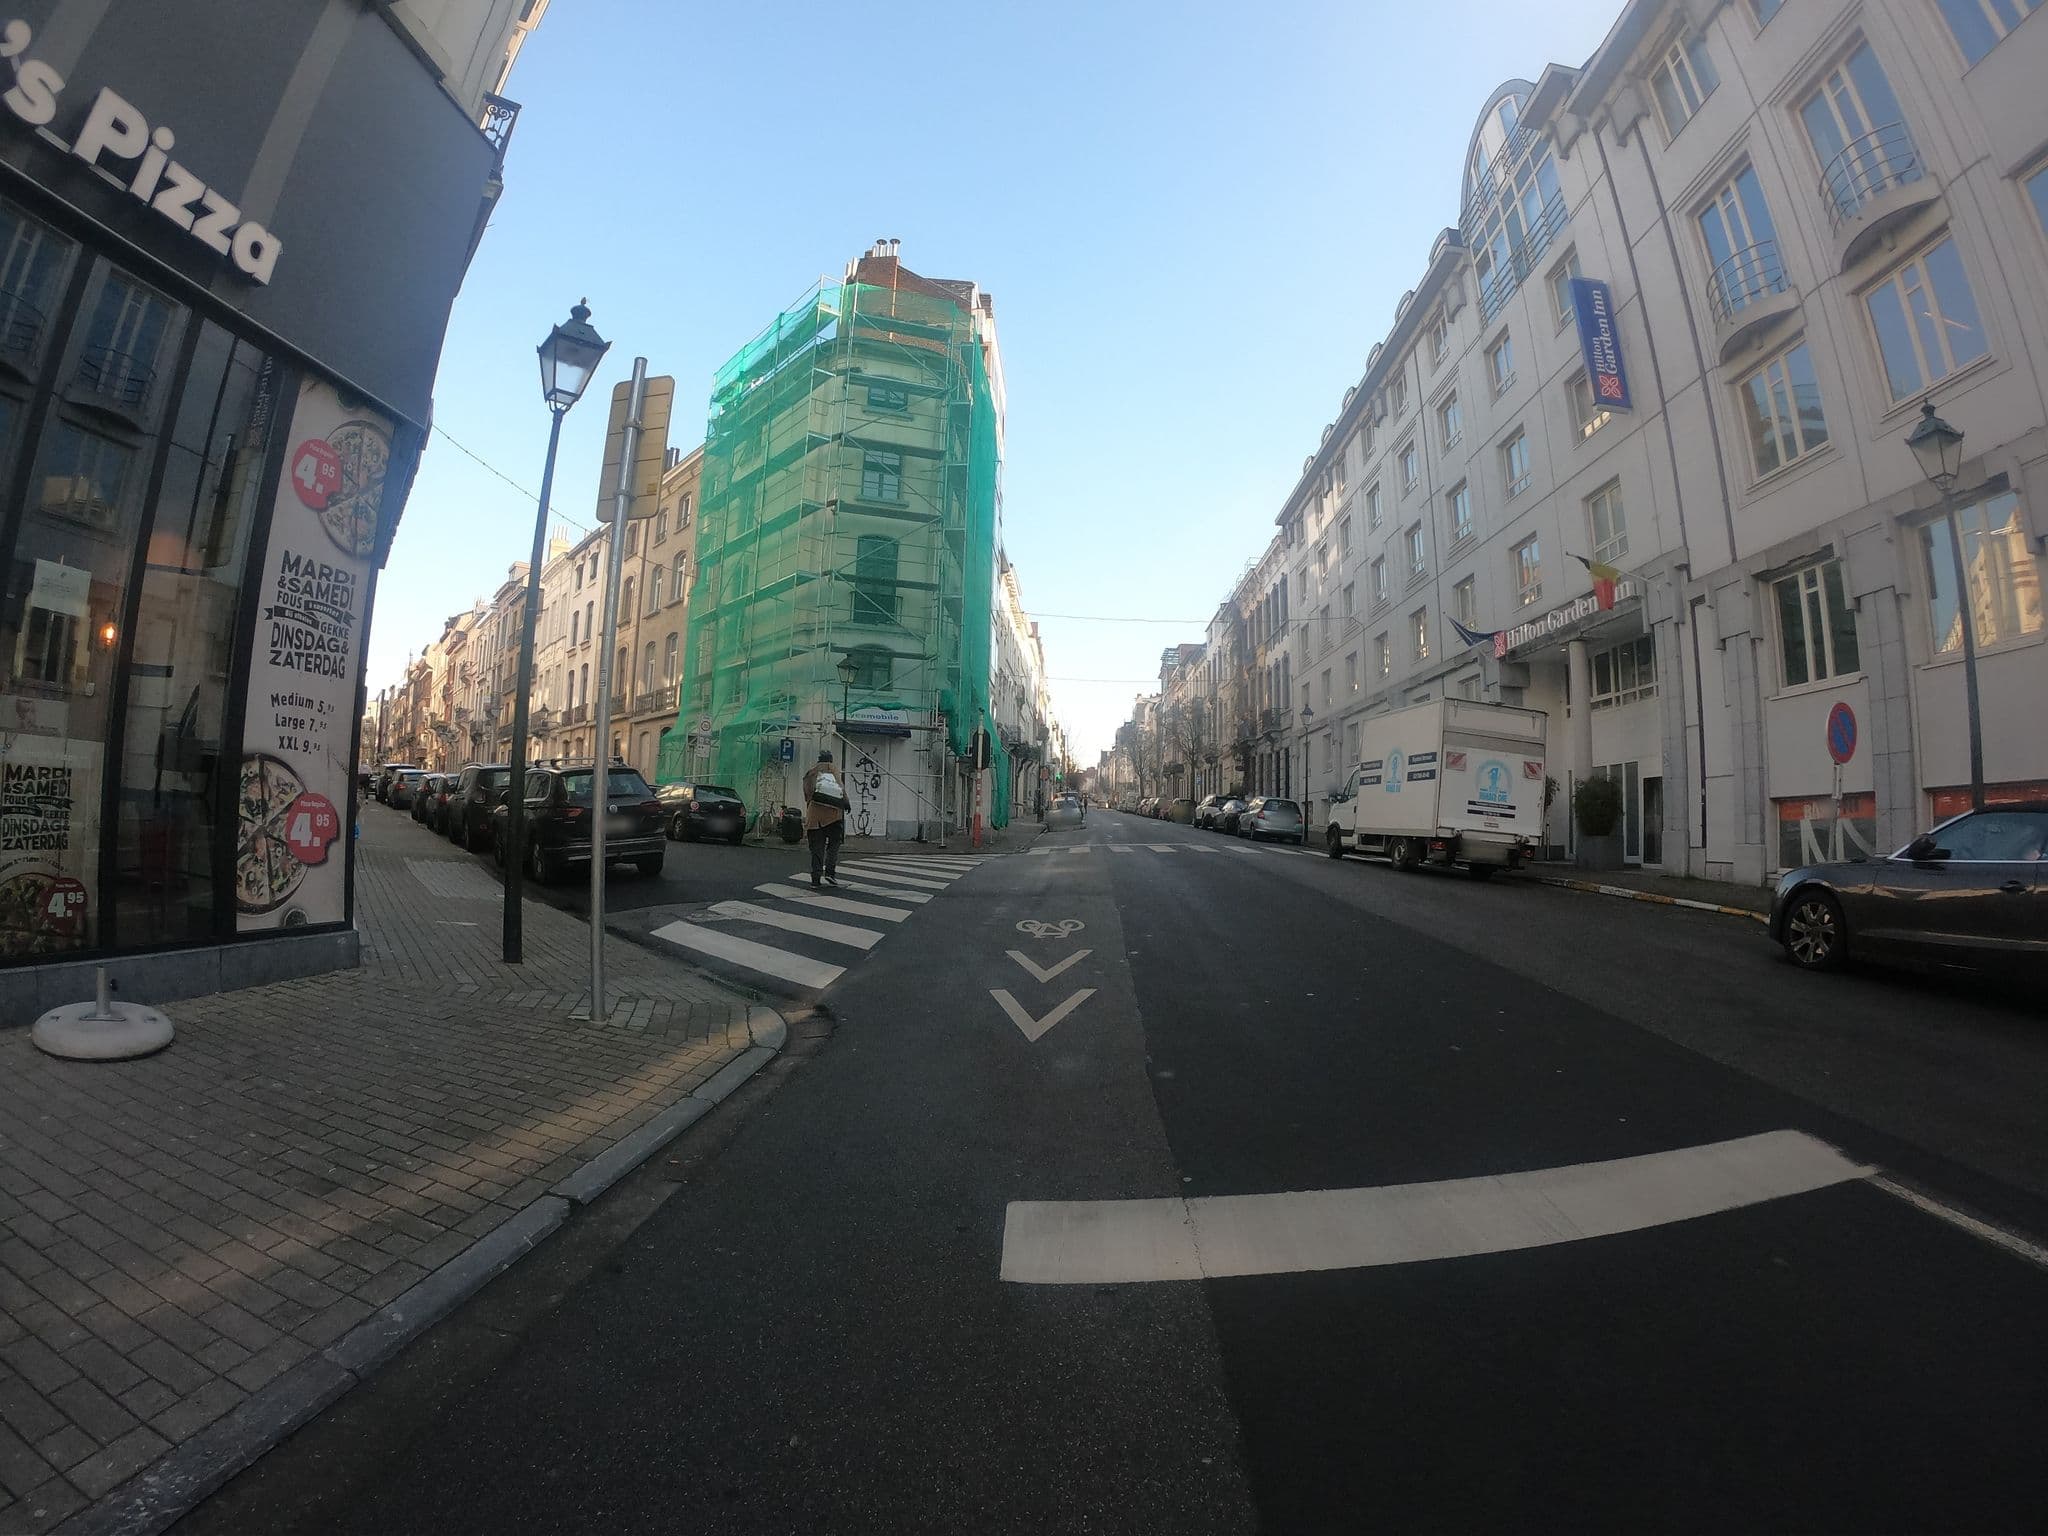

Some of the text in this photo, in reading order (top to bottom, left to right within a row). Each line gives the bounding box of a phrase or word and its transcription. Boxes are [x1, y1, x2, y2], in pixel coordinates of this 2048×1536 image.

[71, 86, 283, 286] Pizza
[1592, 289, 1618, 375] Garden Inn
[280, 549, 357, 585] MARDI
[277, 590, 302, 609] FOUS
[320, 621, 350, 640] GEKKE
[1506, 620, 1546, 650] Hilton
[1547, 596, 1599, 631] Garden
[269, 650, 346, 680] ZATERDAG
[271, 692, 314, 710] Medium
[275, 713, 306, 730] Large
[278, 735, 299, 751] XXL
[783, 740, 792, 753] P
[5, 763, 72, 782] MARDI
[4, 795, 26, 805] FOUS
[290, 812, 330, 848] 4.95
[2, 832, 68, 850] ZATERDAG
[48, 891, 85, 918] 4.95
